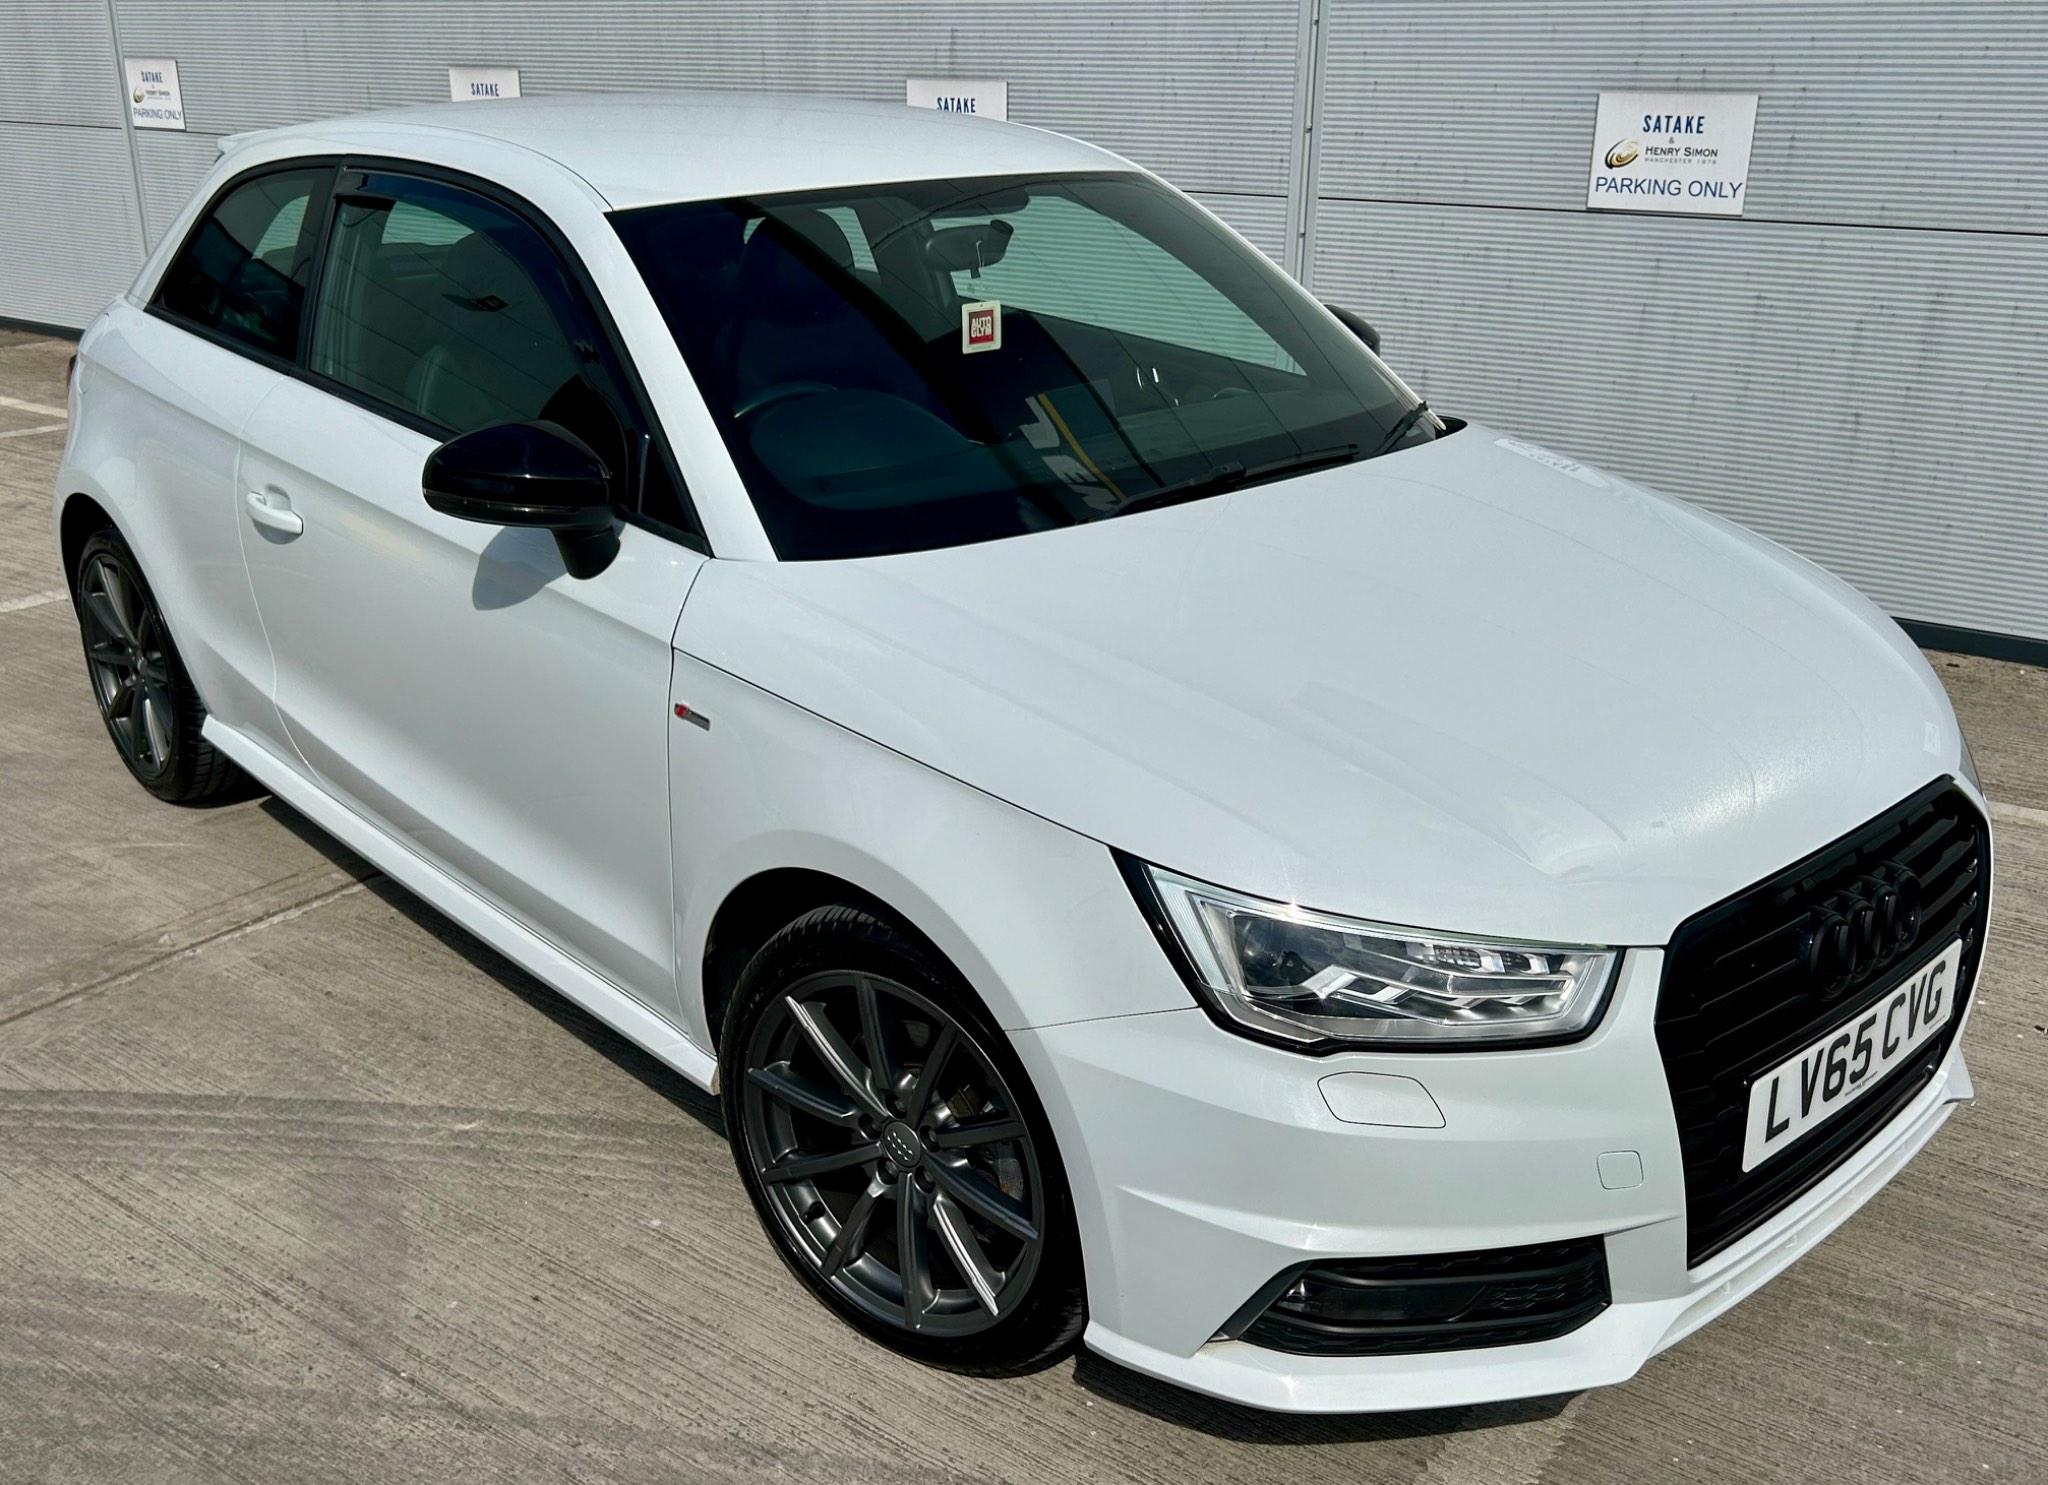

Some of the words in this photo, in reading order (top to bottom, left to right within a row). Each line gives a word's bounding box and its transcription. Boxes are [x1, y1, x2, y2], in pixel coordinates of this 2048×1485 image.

[471, 83, 499, 97] SATAKE
[937, 97, 976, 113] SATAKE
[133, 108, 163, 119] PARKING
[164, 109, 182, 120] ONLY
[1642, 115, 1705, 134] SATAKE
[1645, 146, 1680, 157] HENRY
[1684, 147, 1718, 158] SIMON
[1595, 176, 1682, 196] PARKING
[1688, 180, 1743, 199] ONLY
[1765, 1013, 1877, 1143] LV65
[1881, 960, 1946, 1060] CVG
